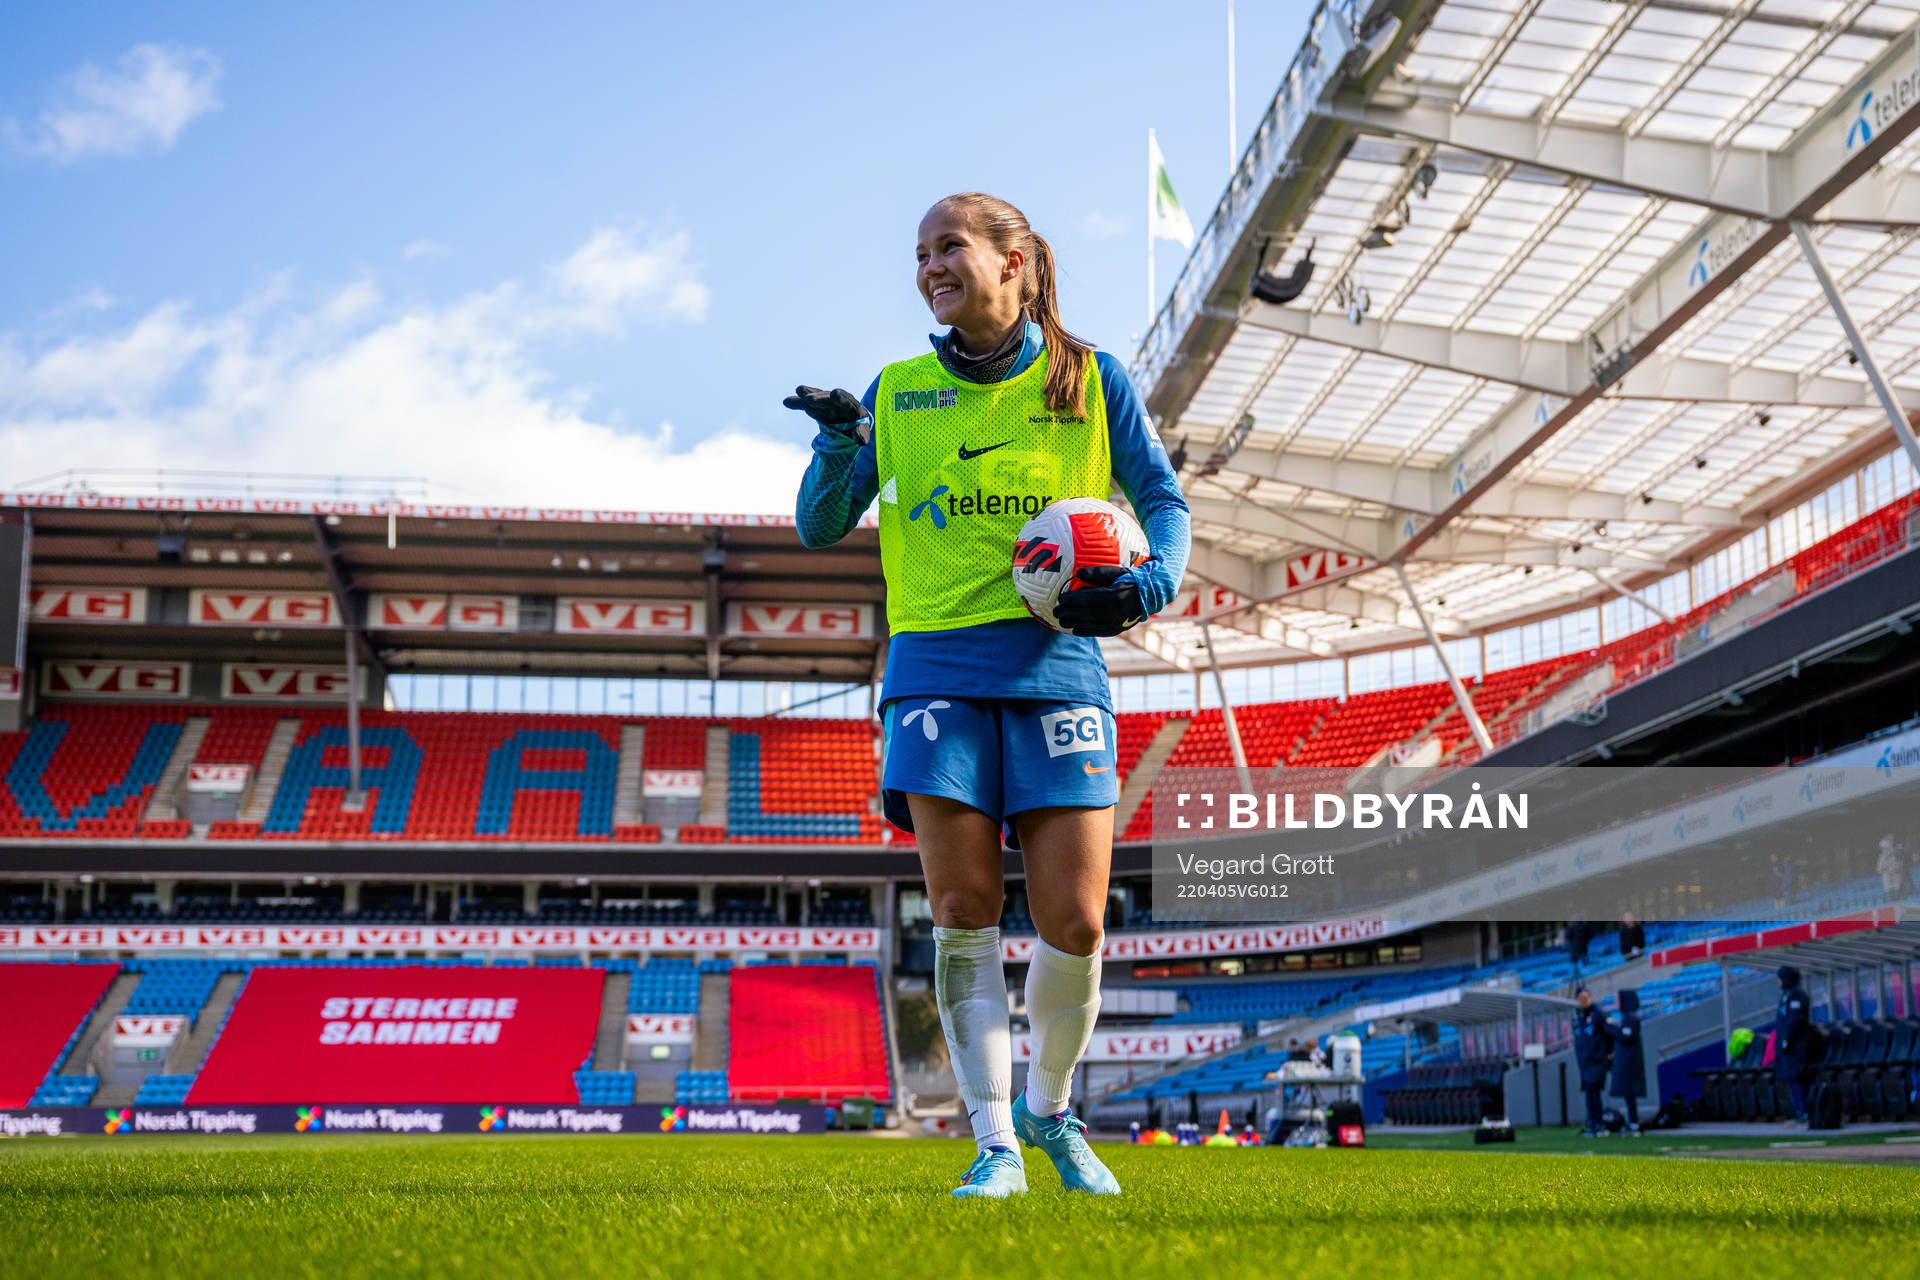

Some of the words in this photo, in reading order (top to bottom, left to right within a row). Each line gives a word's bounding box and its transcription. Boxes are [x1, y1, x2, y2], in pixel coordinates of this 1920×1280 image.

[894, 389, 937, 412] KIWI
[939, 387, 958, 398] mini
[939, 397, 957, 409] pris
[1028, 414, 1053, 424] Norsk
[948, 489, 1052, 517] telenor
[201, 594, 330, 624] VG
[383, 598, 504, 627] VG
[571, 602, 693, 631] VG
[740, 606, 860, 634] VG
[50, 664, 182, 693] VG
[231, 667, 352, 695] VG
[1054, 716, 1099, 747] 5G
[35, 927, 103, 945] VG
[117, 928, 184, 945] VG
[199, 928, 264, 945] VG
[278, 928, 344, 945] VG
[358, 929, 422, 945] VG
[435, 929, 499, 945] VG
[512, 929, 576, 945] VG
[589, 929, 651, 945] VG
[664, 930, 726, 946] VG
[738, 930, 800, 946] VG
[812, 930, 874, 946] VG
[320, 997, 518, 1019] STERKERE
[319, 1021, 502, 1044] SAMMEN
[134, 1111, 189, 1131] Norsk
[189, 1110, 257, 1134] Tipping
[324, 1109, 377, 1129] Norsk
[377, 1109, 443, 1133] Tipping
[507, 1108, 559, 1129] Norsk
[558, 1108, 623, 1132] Tipping
[688, 1109, 738, 1129] Norsk
[737, 1109, 801, 1133] Tipping
